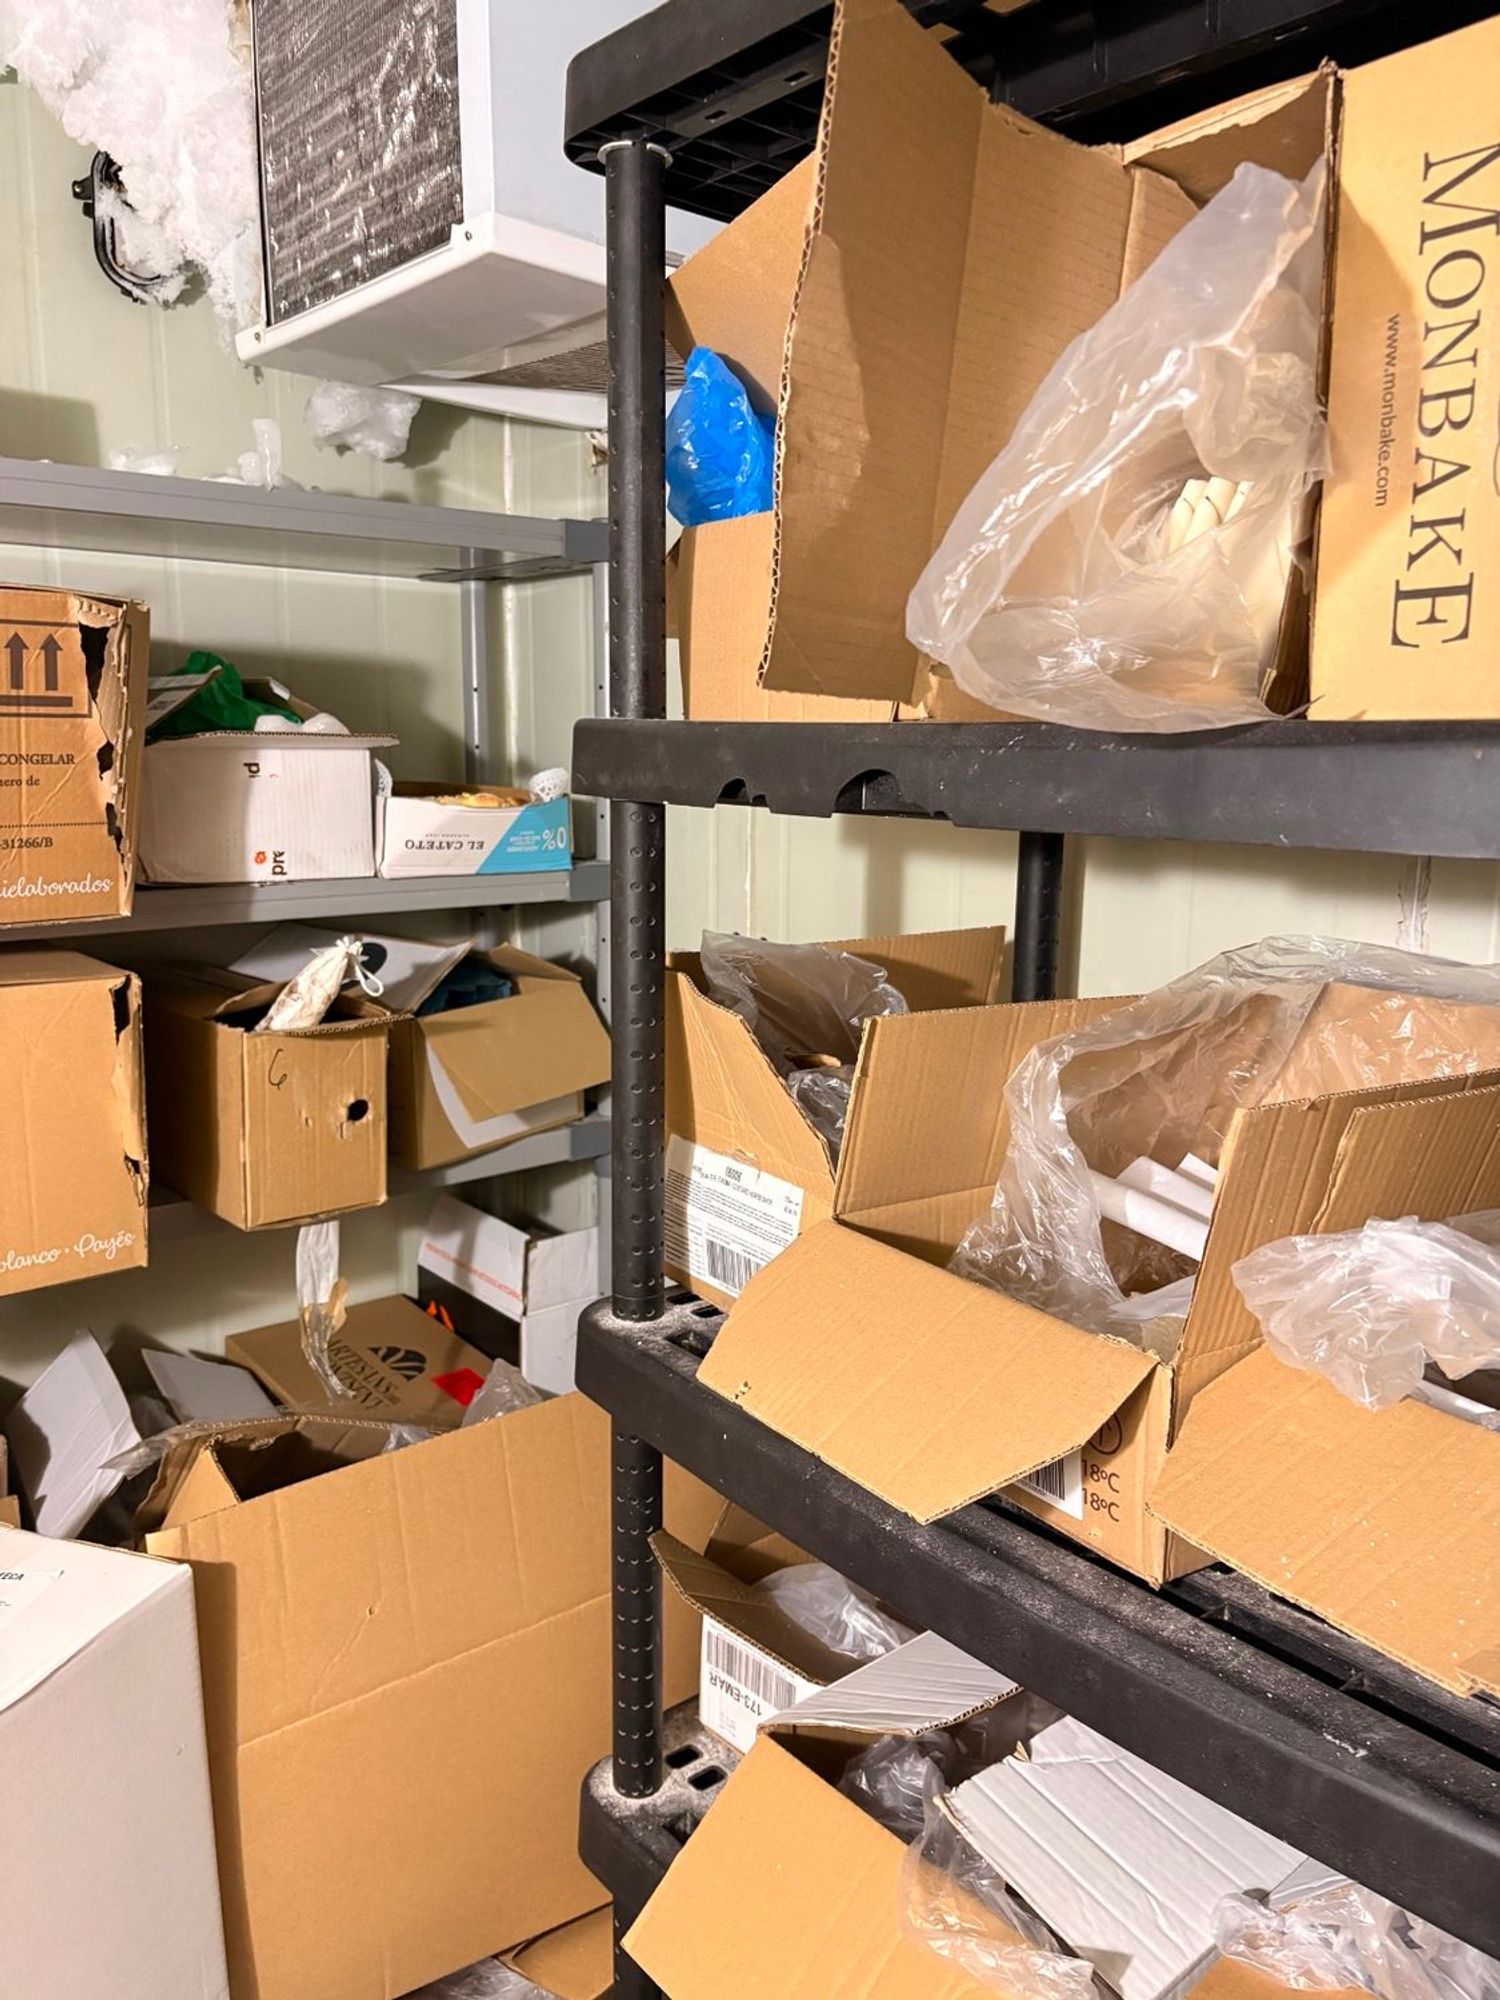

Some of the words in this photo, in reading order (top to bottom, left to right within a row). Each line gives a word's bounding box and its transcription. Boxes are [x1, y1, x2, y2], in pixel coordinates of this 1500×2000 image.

[1391, 142, 1500, 648] MONBAKE
[1375, 313, 1400, 507] www.monbake.com
[26, 775, 41, 786] de
[405, 839, 464, 851] CATETO
[468, 839, 485, 850] EL
[0, 873, 113, 898] ielaborados
[74, 1230, 136, 1260] Payés
